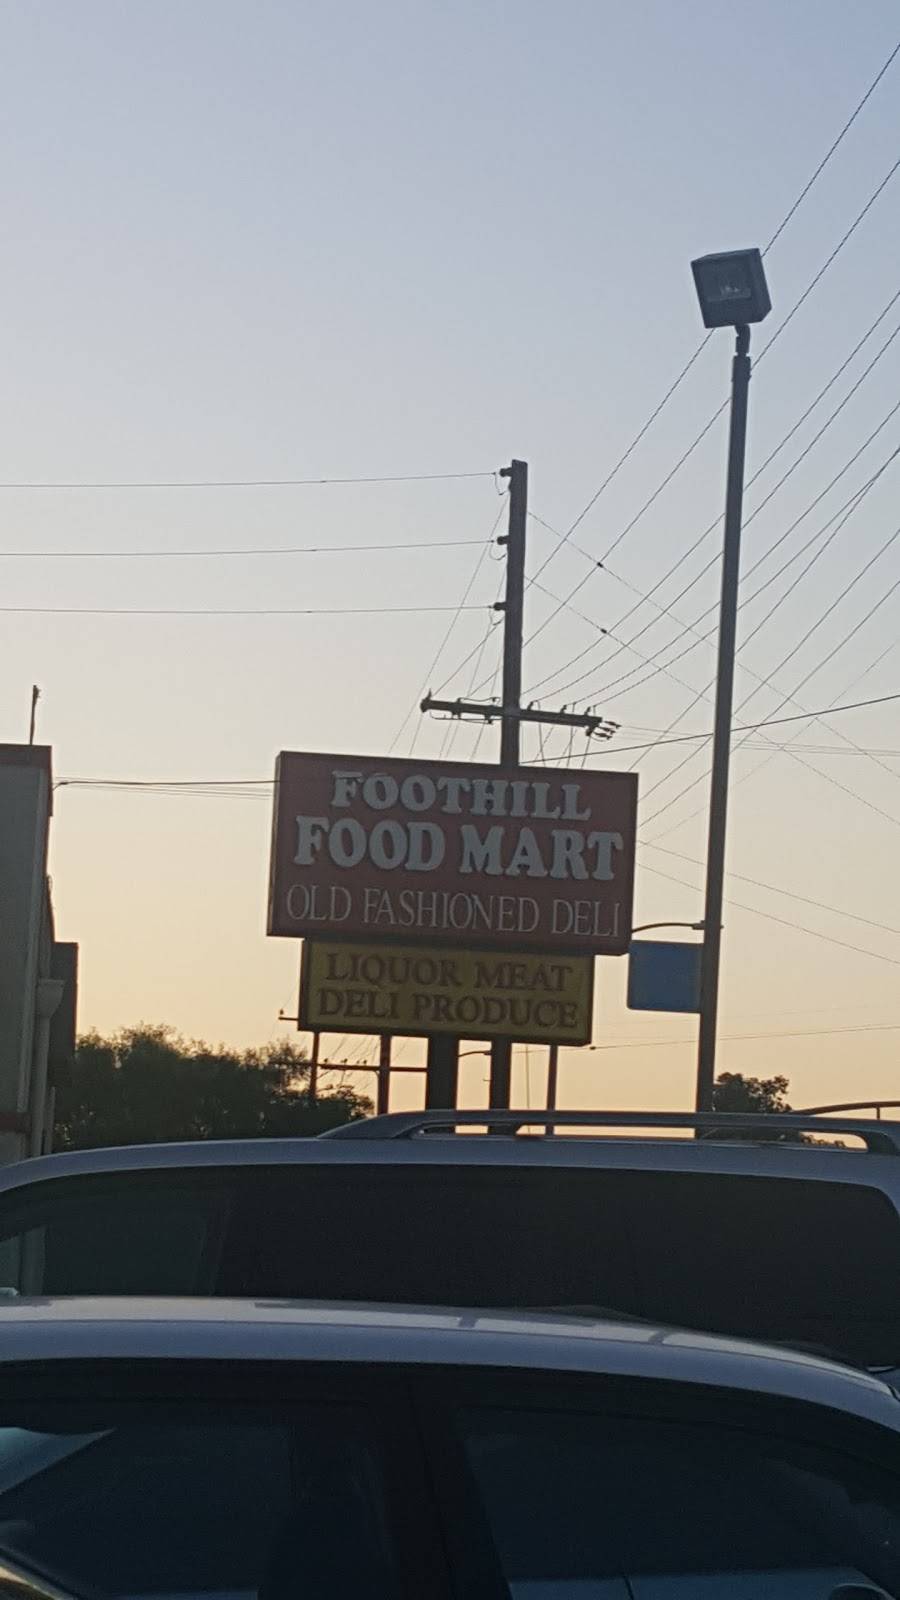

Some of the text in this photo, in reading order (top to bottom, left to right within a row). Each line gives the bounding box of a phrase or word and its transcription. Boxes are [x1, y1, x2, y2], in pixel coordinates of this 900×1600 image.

[330, 770, 592, 821] FOOTHILL
[294, 815, 624, 881] FOOD MART
[287, 884, 621, 937] OLD FASHIONED DELI
[326, 953, 574, 991] LIQUOR MEAT
[317, 988, 579, 1029] DELI PRODUCE
